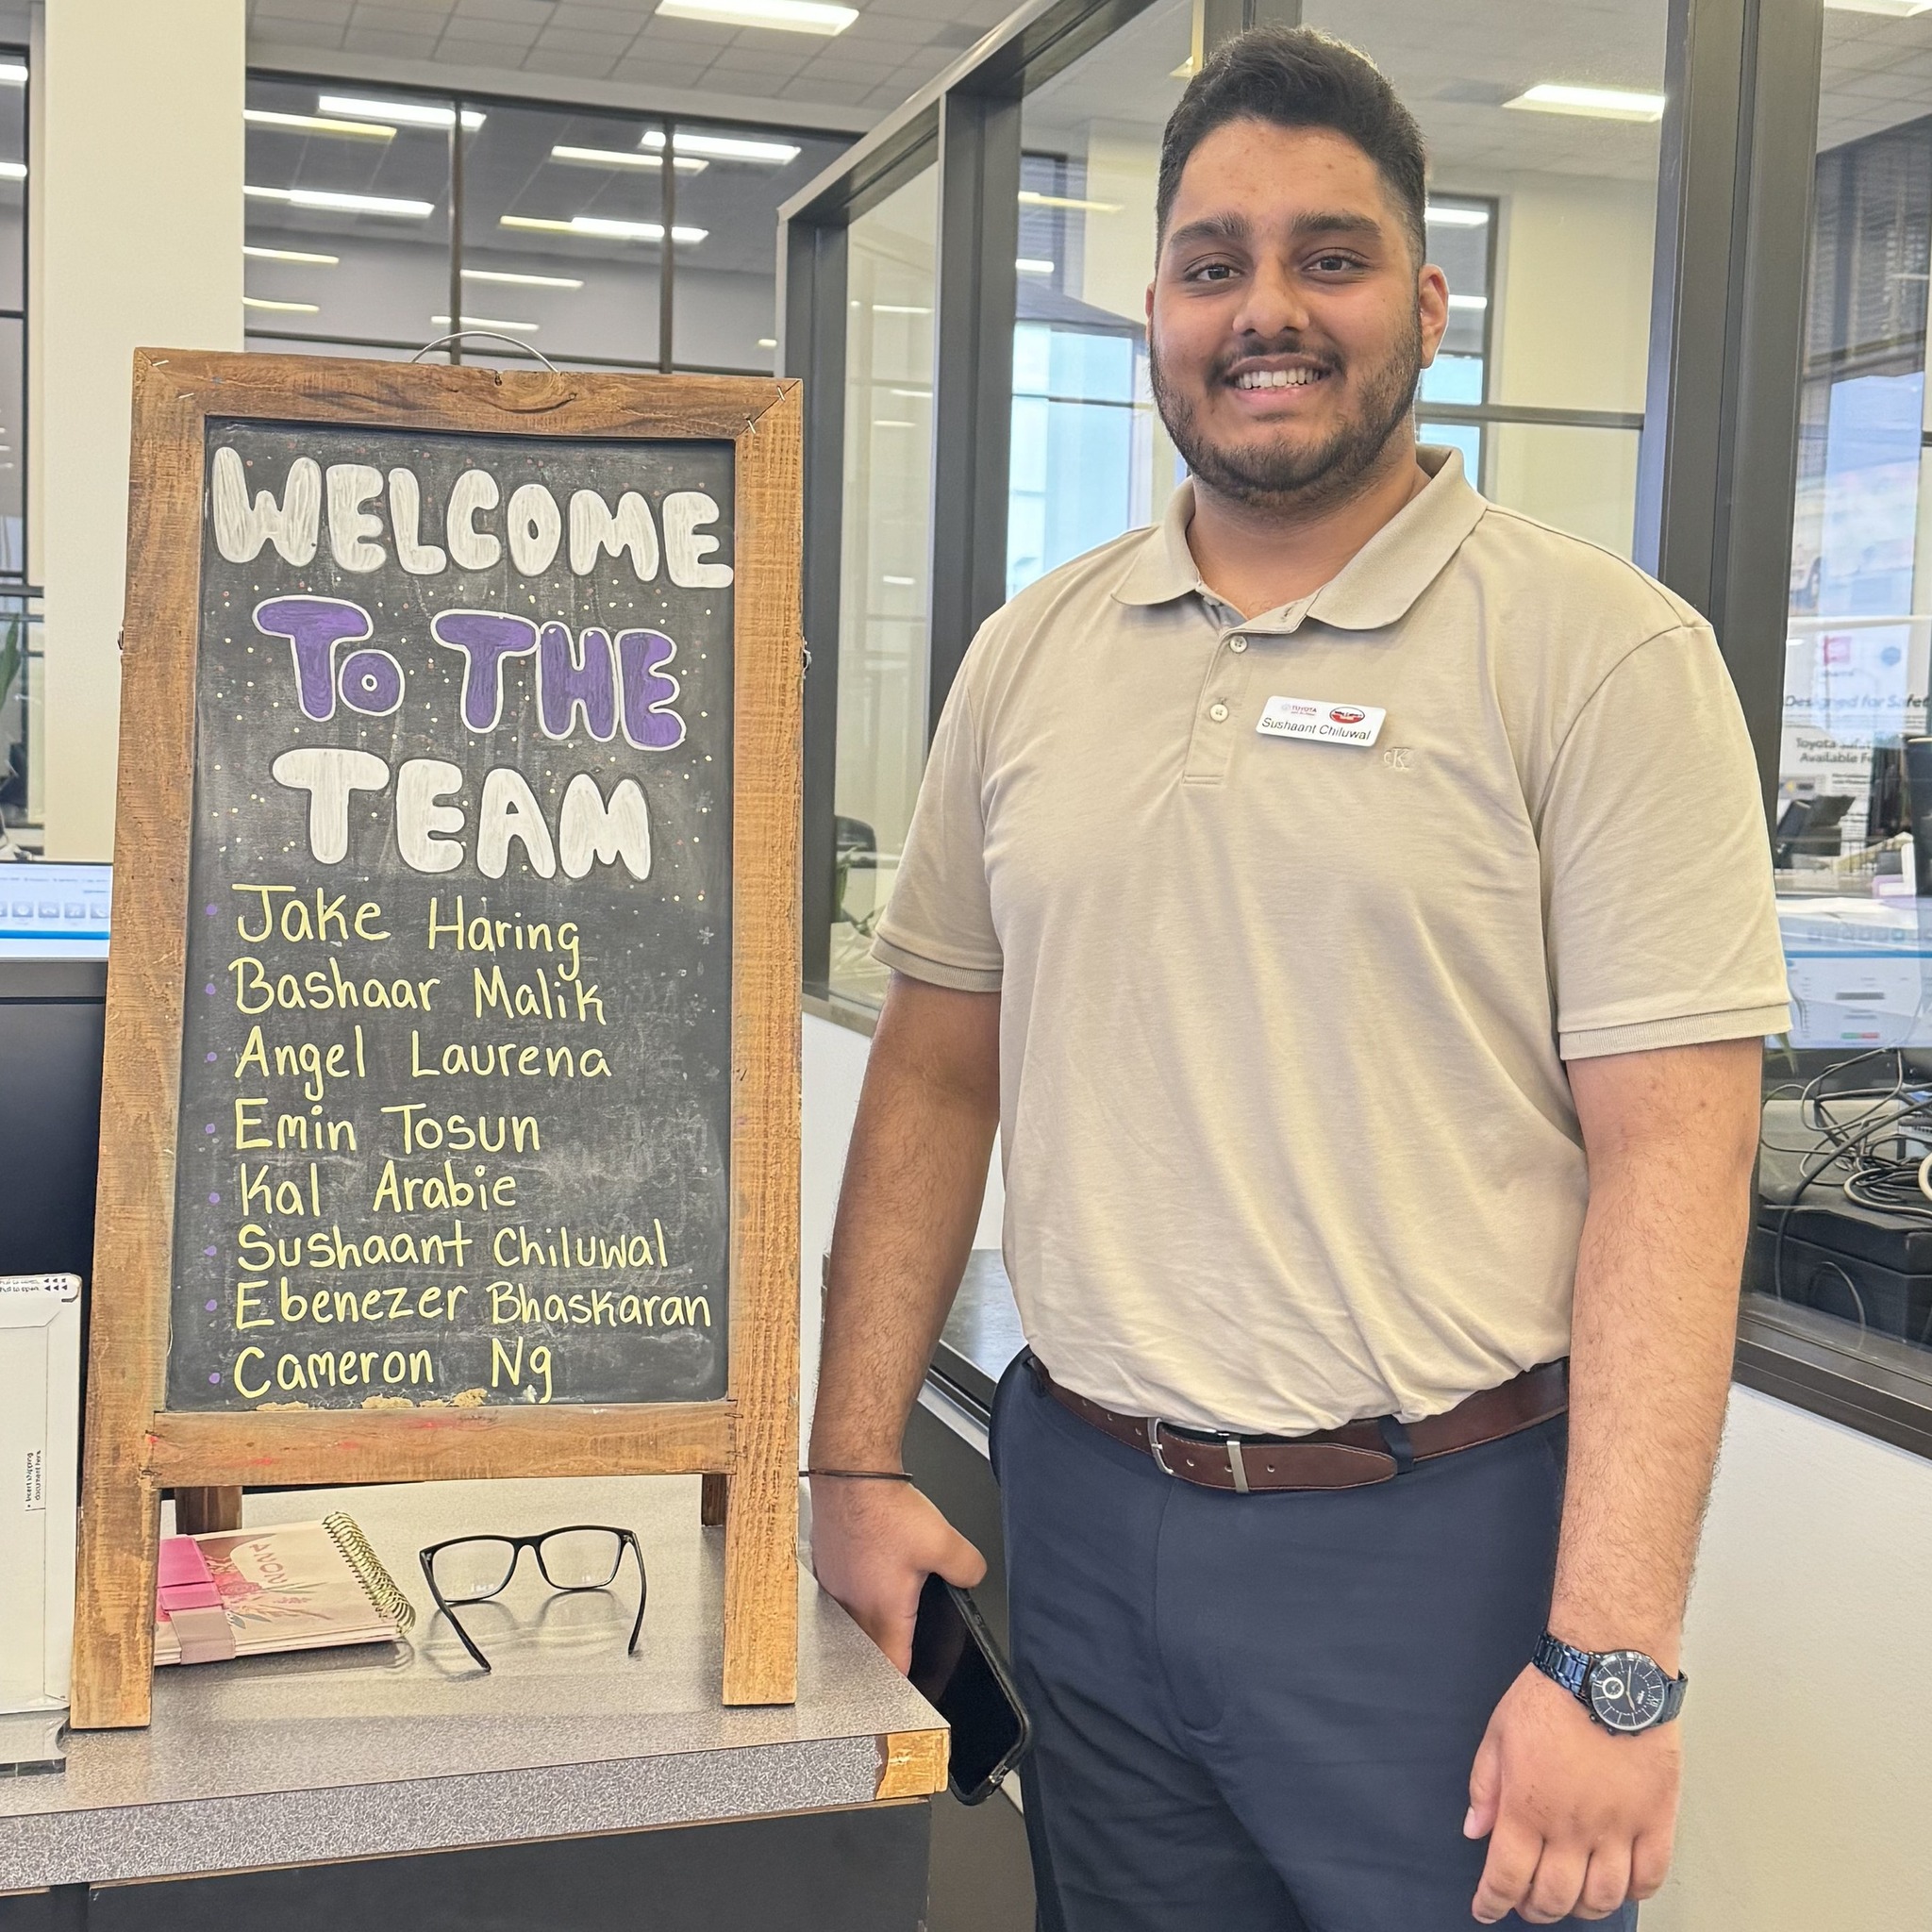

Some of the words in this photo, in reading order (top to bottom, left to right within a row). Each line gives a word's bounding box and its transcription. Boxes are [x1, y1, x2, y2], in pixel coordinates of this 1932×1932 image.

[213, 446, 735, 588] WELCOME
[430, 608, 688, 750] THE
[1262, 717, 1316, 734] Sushaant
[1319, 724, 1372, 741] Chiluwal
[272, 747, 651, 881] TEAM
[232, 883, 391, 942] Jake
[428, 895, 580, 981] Haring
[228, 957, 441, 1015] Bashaar
[473, 965, 607, 1025] Malik
[234, 1024, 365, 1101] Angel
[410, 1030, 612, 1078] Laurena
[234, 1097, 358, 1150] Emin
[380, 1103, 541, 1154] Tosun
[240, 1162, 321, 1217] Kal
[373, 1159, 517, 1213] Arabie
[237, 1219, 473, 1271] Sushaant
[492, 1219, 669, 1268] Chiluwal
[237, 1276, 469, 1330] Ebenezer
[485, 1280, 711, 1327] Bhaskaran
[233, 1346, 433, 1399] Cameron
[491, 1338, 552, 1403] Ng
